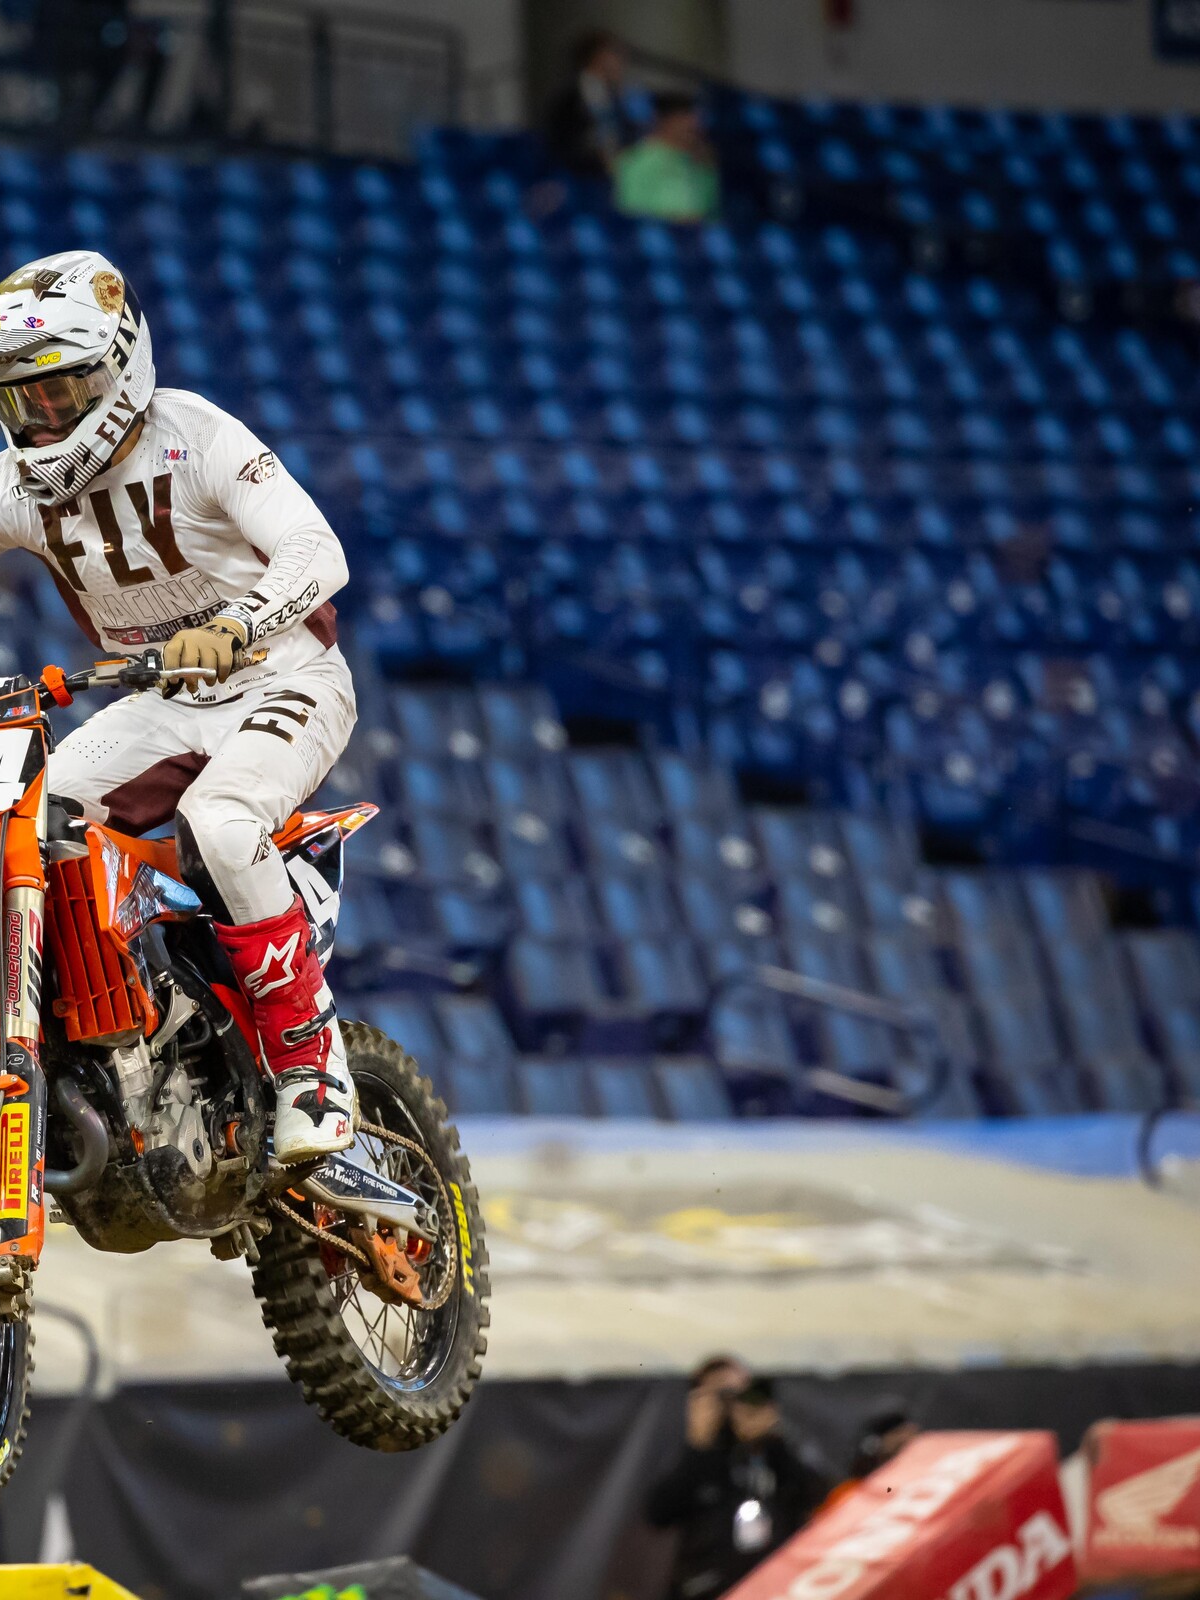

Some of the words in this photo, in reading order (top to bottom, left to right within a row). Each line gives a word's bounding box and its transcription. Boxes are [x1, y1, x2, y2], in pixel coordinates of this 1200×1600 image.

[101, 302, 139, 380] FLY
[95, 390, 137, 447] FLY
[163, 449, 188, 461] AMA
[38, 473, 193, 592] FLY
[90, 570, 220, 627] RACING
[145, 618, 186, 639] RONNIE
[3, 706, 30, 718] AMA
[238, 689, 317, 746] FLY
[449, 1182, 475, 1297] PIRELLI
